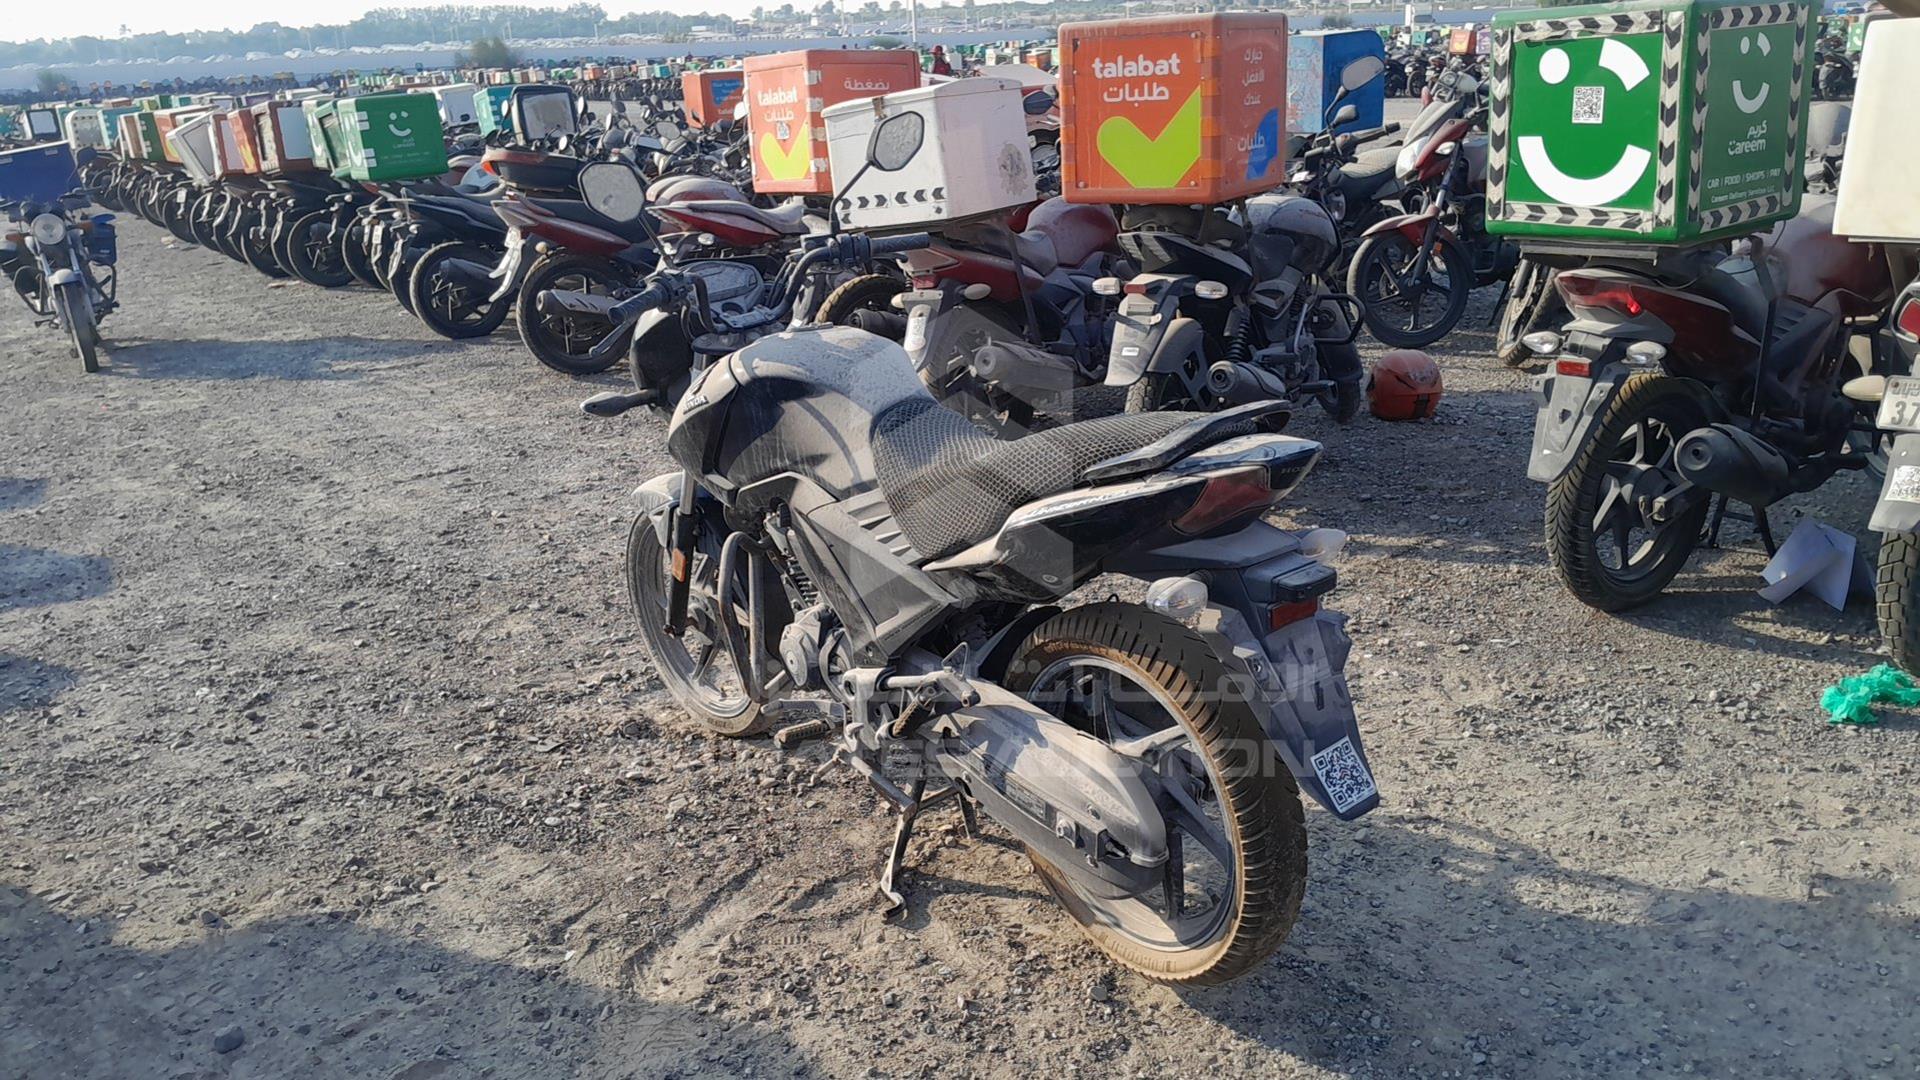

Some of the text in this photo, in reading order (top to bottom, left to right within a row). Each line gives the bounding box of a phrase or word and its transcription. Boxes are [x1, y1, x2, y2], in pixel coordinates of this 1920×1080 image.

[1092, 52, 1181, 79] talabat
[757, 86, 798, 106] talabat
[1103, 81, 1169, 107] طلبات
[764, 106, 795, 122] طلبات
[1747, 119, 1767, 139] كريم
[1237, 131, 1265, 154] طلبات
[1707, 178, 1720, 189] CAR
[1724, 175, 1741, 187] FOOD
